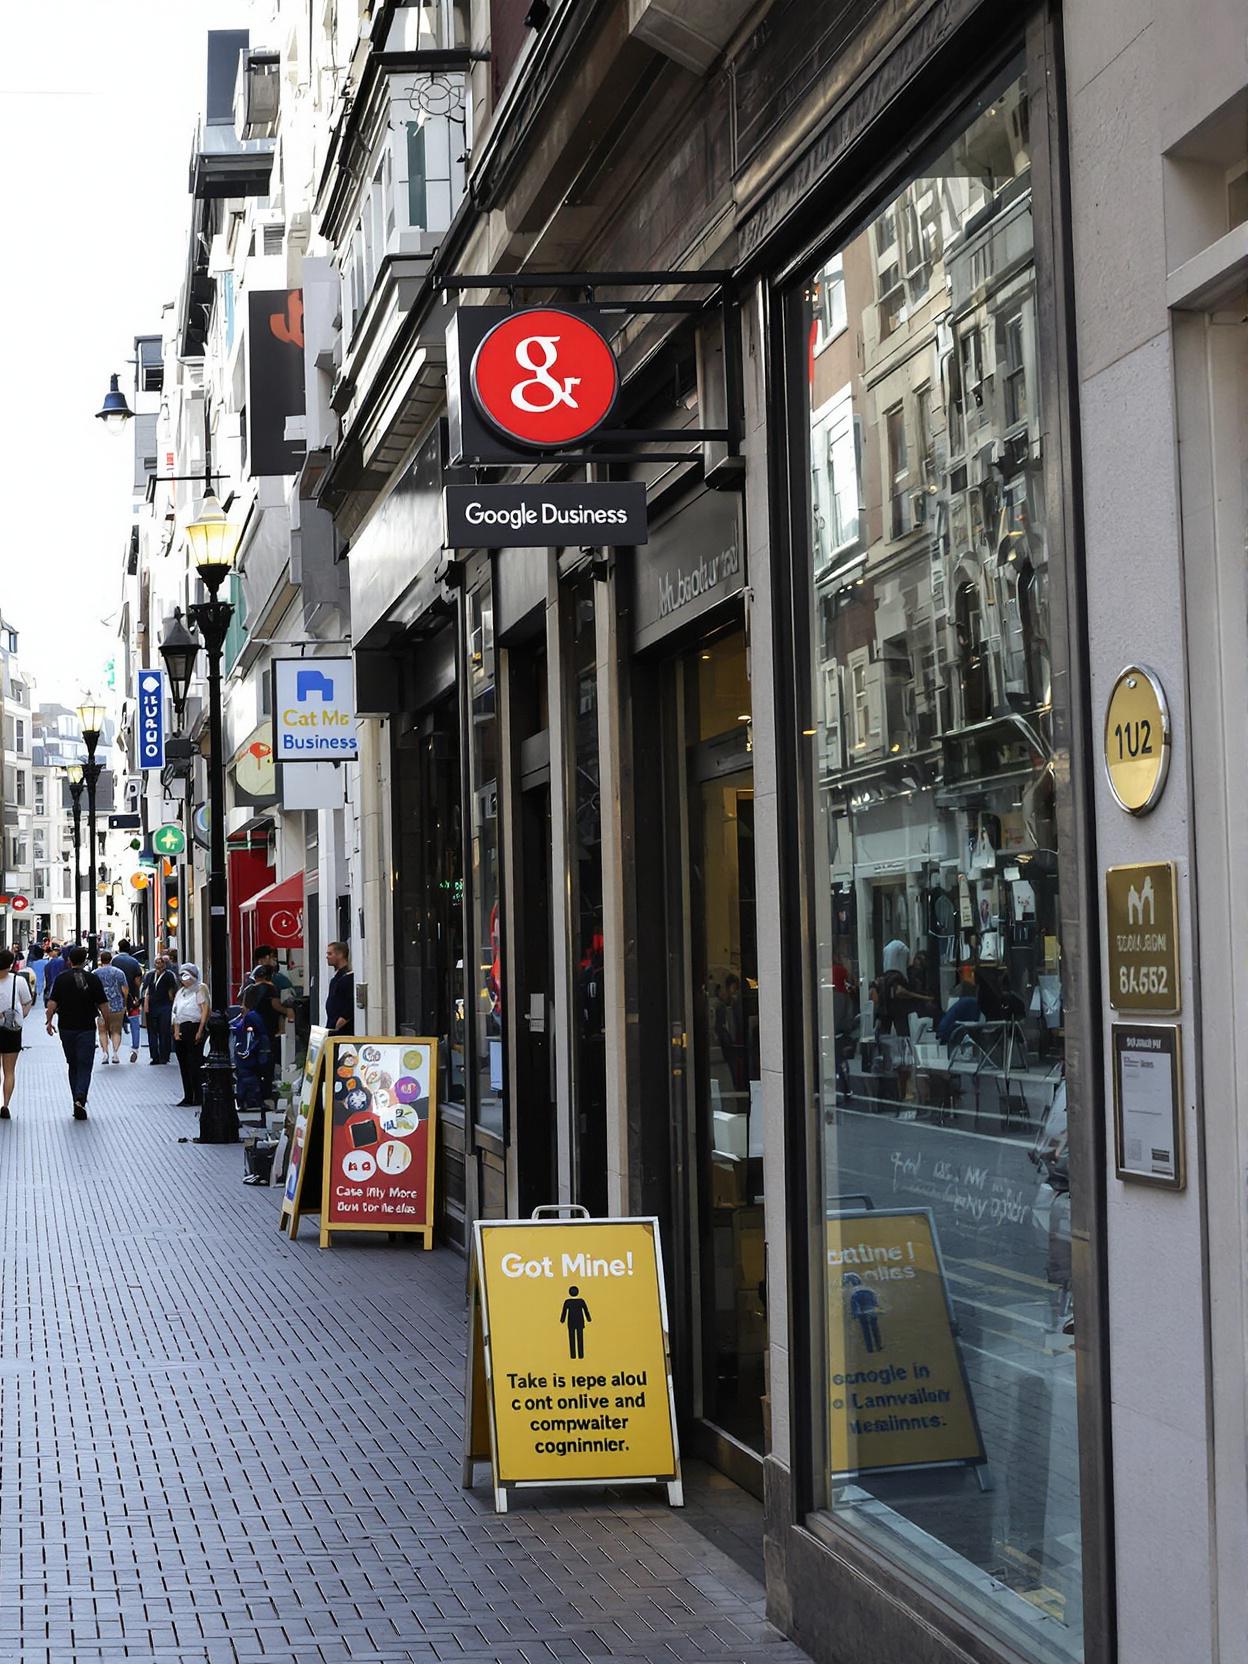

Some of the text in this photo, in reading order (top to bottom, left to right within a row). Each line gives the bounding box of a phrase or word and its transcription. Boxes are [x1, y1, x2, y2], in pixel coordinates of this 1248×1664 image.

[465, 502, 538, 530] Google
[283, 709, 318, 726] Cat
[283, 734, 357, 749] Business
[501, 1251, 633, 1278] Got Mine!
[507, 1373, 547, 1389] Take
[553, 1373, 566, 1388] is
[615, 1392, 645, 1408] and
